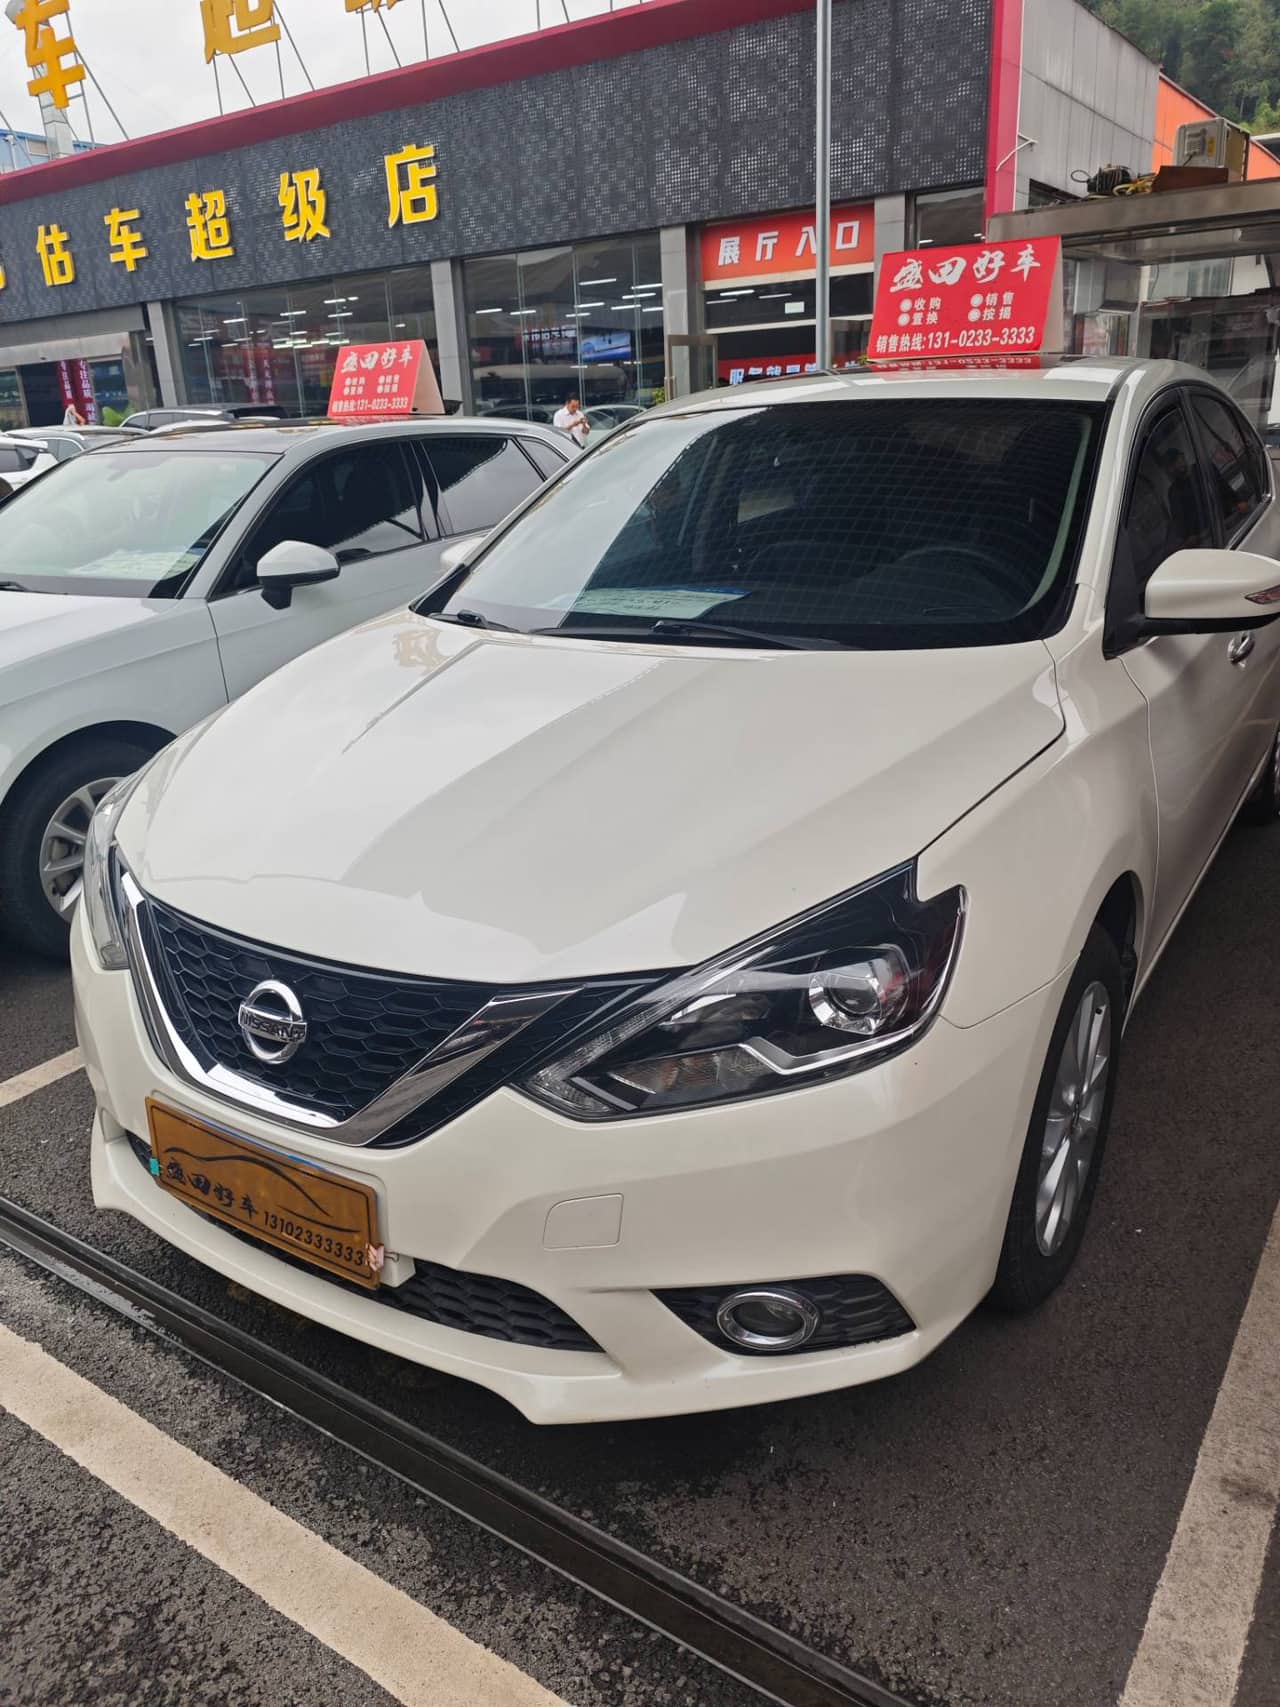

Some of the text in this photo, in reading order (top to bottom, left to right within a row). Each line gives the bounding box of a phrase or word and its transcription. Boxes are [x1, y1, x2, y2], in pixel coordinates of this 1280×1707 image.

[0, 144, 438, 289] 估车超级店
[717, 220, 860, 266] 展厅入口
[890, 244, 1040, 293] 盛田好车
[914, 296, 942, 312] 收购
[982, 306, 1012, 321] 按揭
[985, 291, 1014, 307] 销售
[911, 310, 938, 326] 置换
[240, 1006, 303, 1042] NISSAN
[264, 1211, 364, 1266] 13102333333
